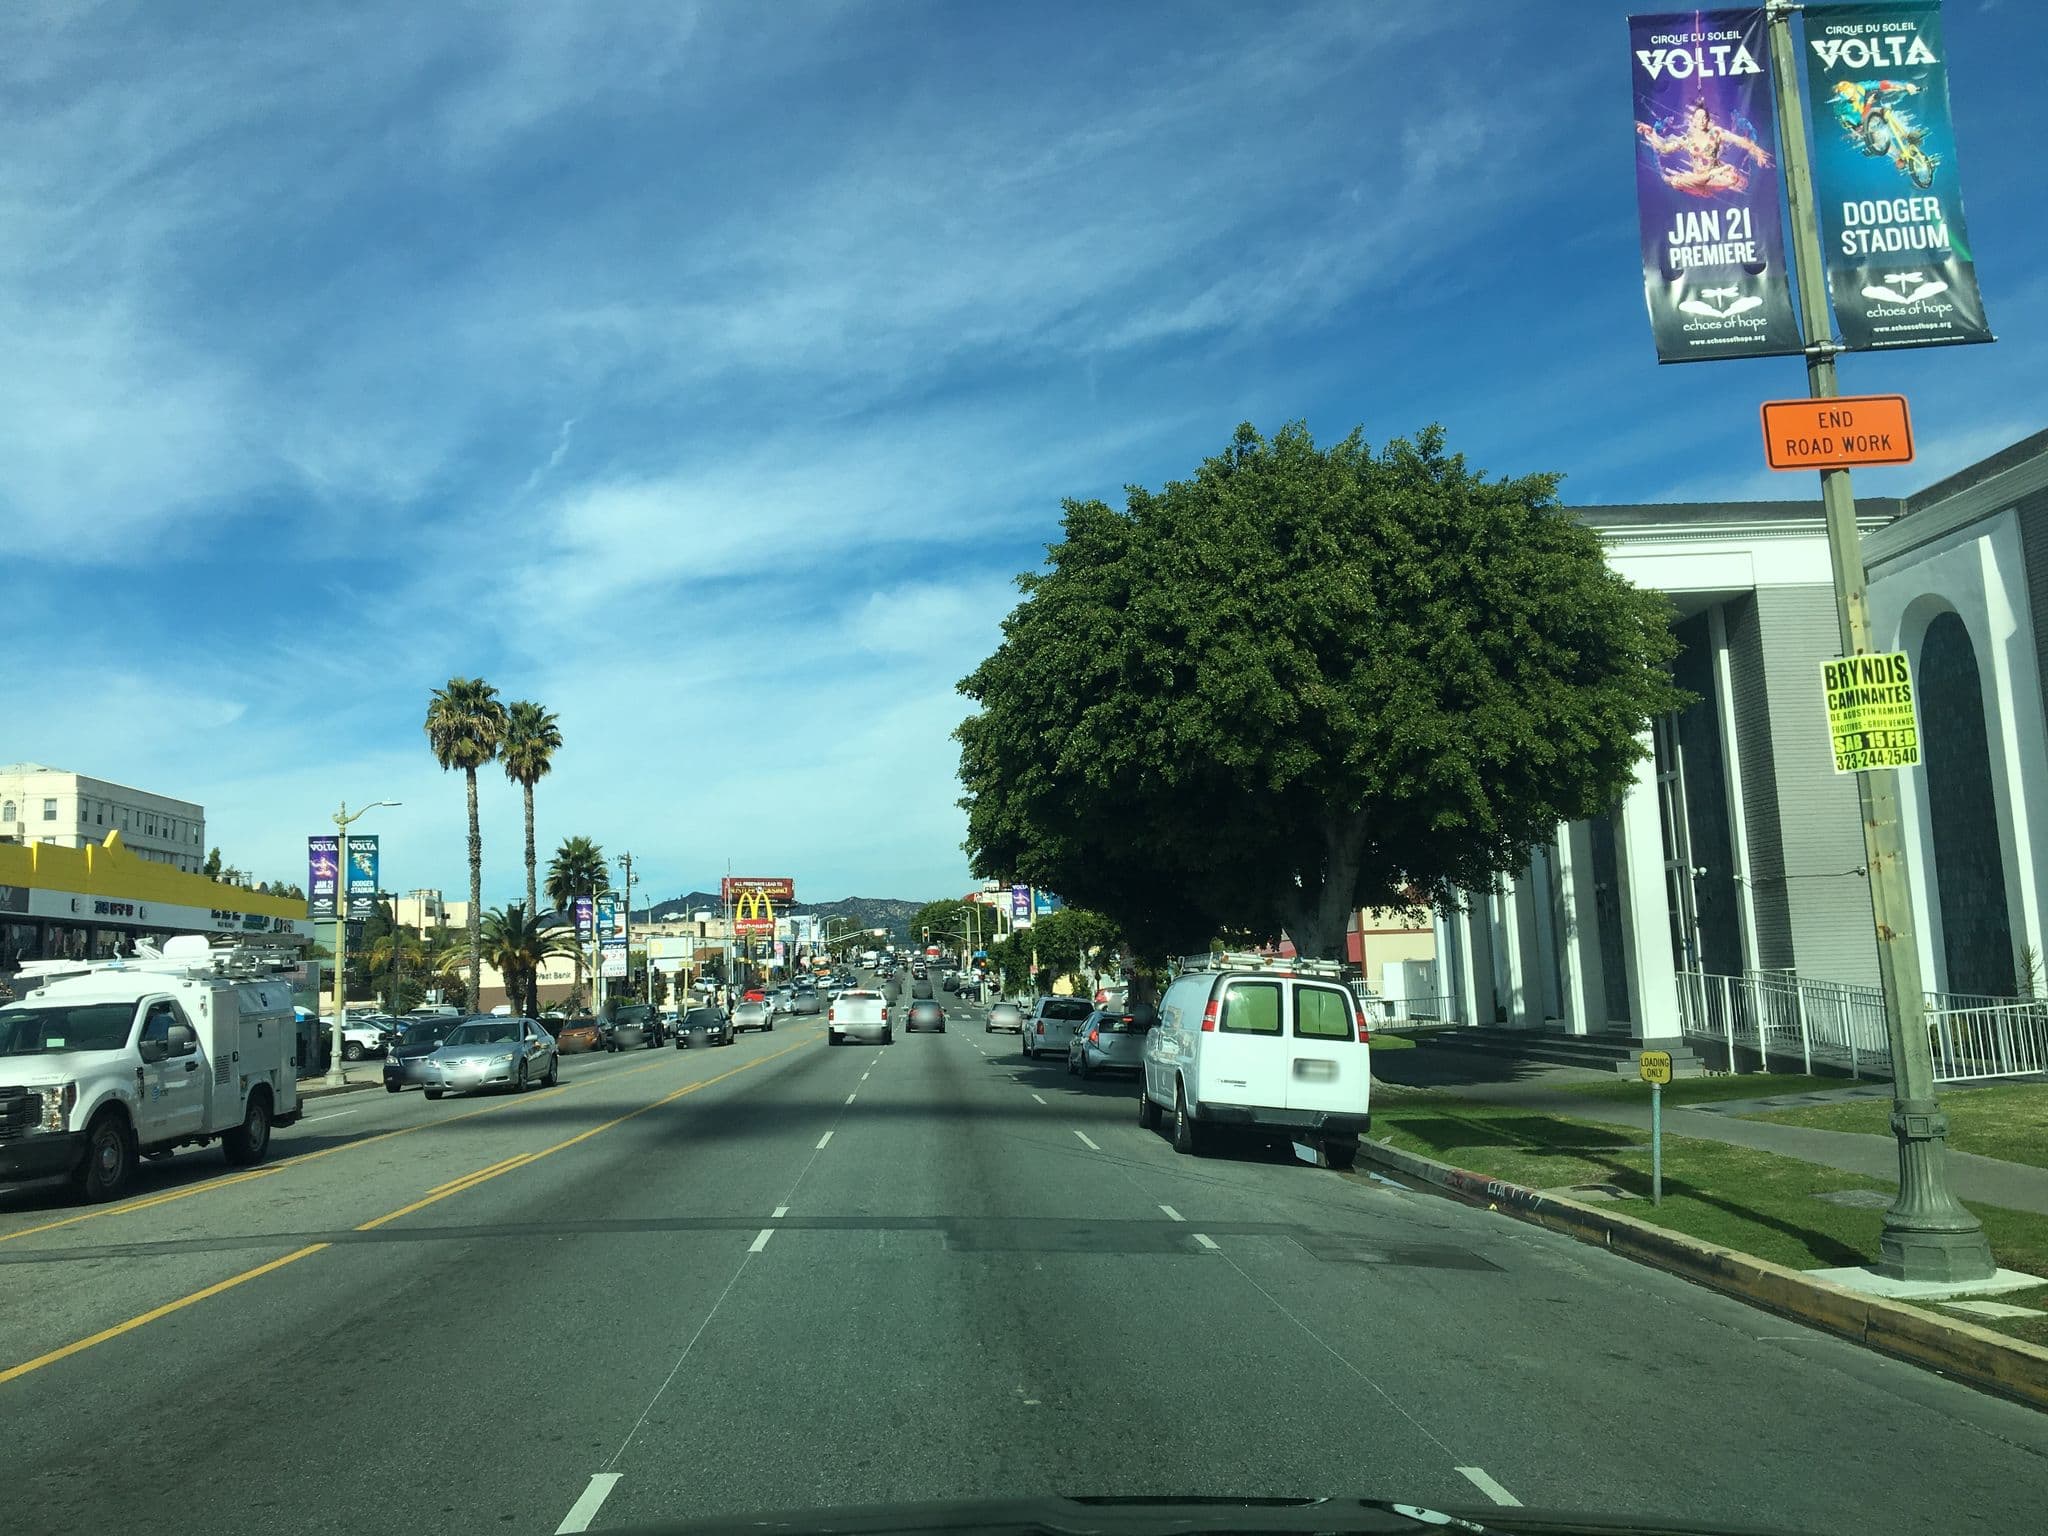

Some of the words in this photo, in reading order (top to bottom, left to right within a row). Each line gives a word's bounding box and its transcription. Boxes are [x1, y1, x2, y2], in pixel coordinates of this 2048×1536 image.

[1651, 33, 1689, 45] CIRQUE
[1690, 32, 1705, 42] DU
[1707, 30, 1742, 40] SOLEIL
[1825, 24, 1863, 36] CIRQUE
[1865, 23, 1880, 33] DU
[1882, 22, 1917, 32] SOLEIL
[1635, 44, 1762, 81] VOLTA
[1810, 35, 1938, 69] VOLTA
[1842, 196, 1942, 226] DODGER
[1668, 210, 1721, 245] JAN
[1725, 207, 1752, 240] 21
[1841, 223, 1950, 255] STADIUM
[1669, 241, 1757, 269] PREMIERE
[1866, 303, 1906, 318] echoes
[1908, 300, 1921, 315] of
[1921, 300, 1953, 318] hope
[1683, 317, 1722, 331] echoes
[1724, 314, 1737, 329] of
[1737, 314, 1768, 332] hope
[1818, 411, 1853, 429] END
[1786, 437, 1833, 457] ROAD
[1841, 434, 1892, 453] WORK
[1824, 654, 1908, 691] BRYNDIS
[1827, 684, 1911, 711] CAMINANTES
[1830, 712, 1841, 722] DE
[1843, 707, 1876, 721] AGUSTIN
[1878, 704, 1913, 716] RAMIREZ
[1833, 734, 1863, 754] SAB
[1865, 731, 1885, 749] 15
[1887, 729, 1915, 748] FEB
[1836, 747, 1918, 771] 323-244-2540
[310, 843, 338, 852] VOLTA
[349, 842, 377, 851] VOLTA
[1641, 1057, 1669, 1067] LOADING
[1646, 1068, 1663, 1078] ONLY
